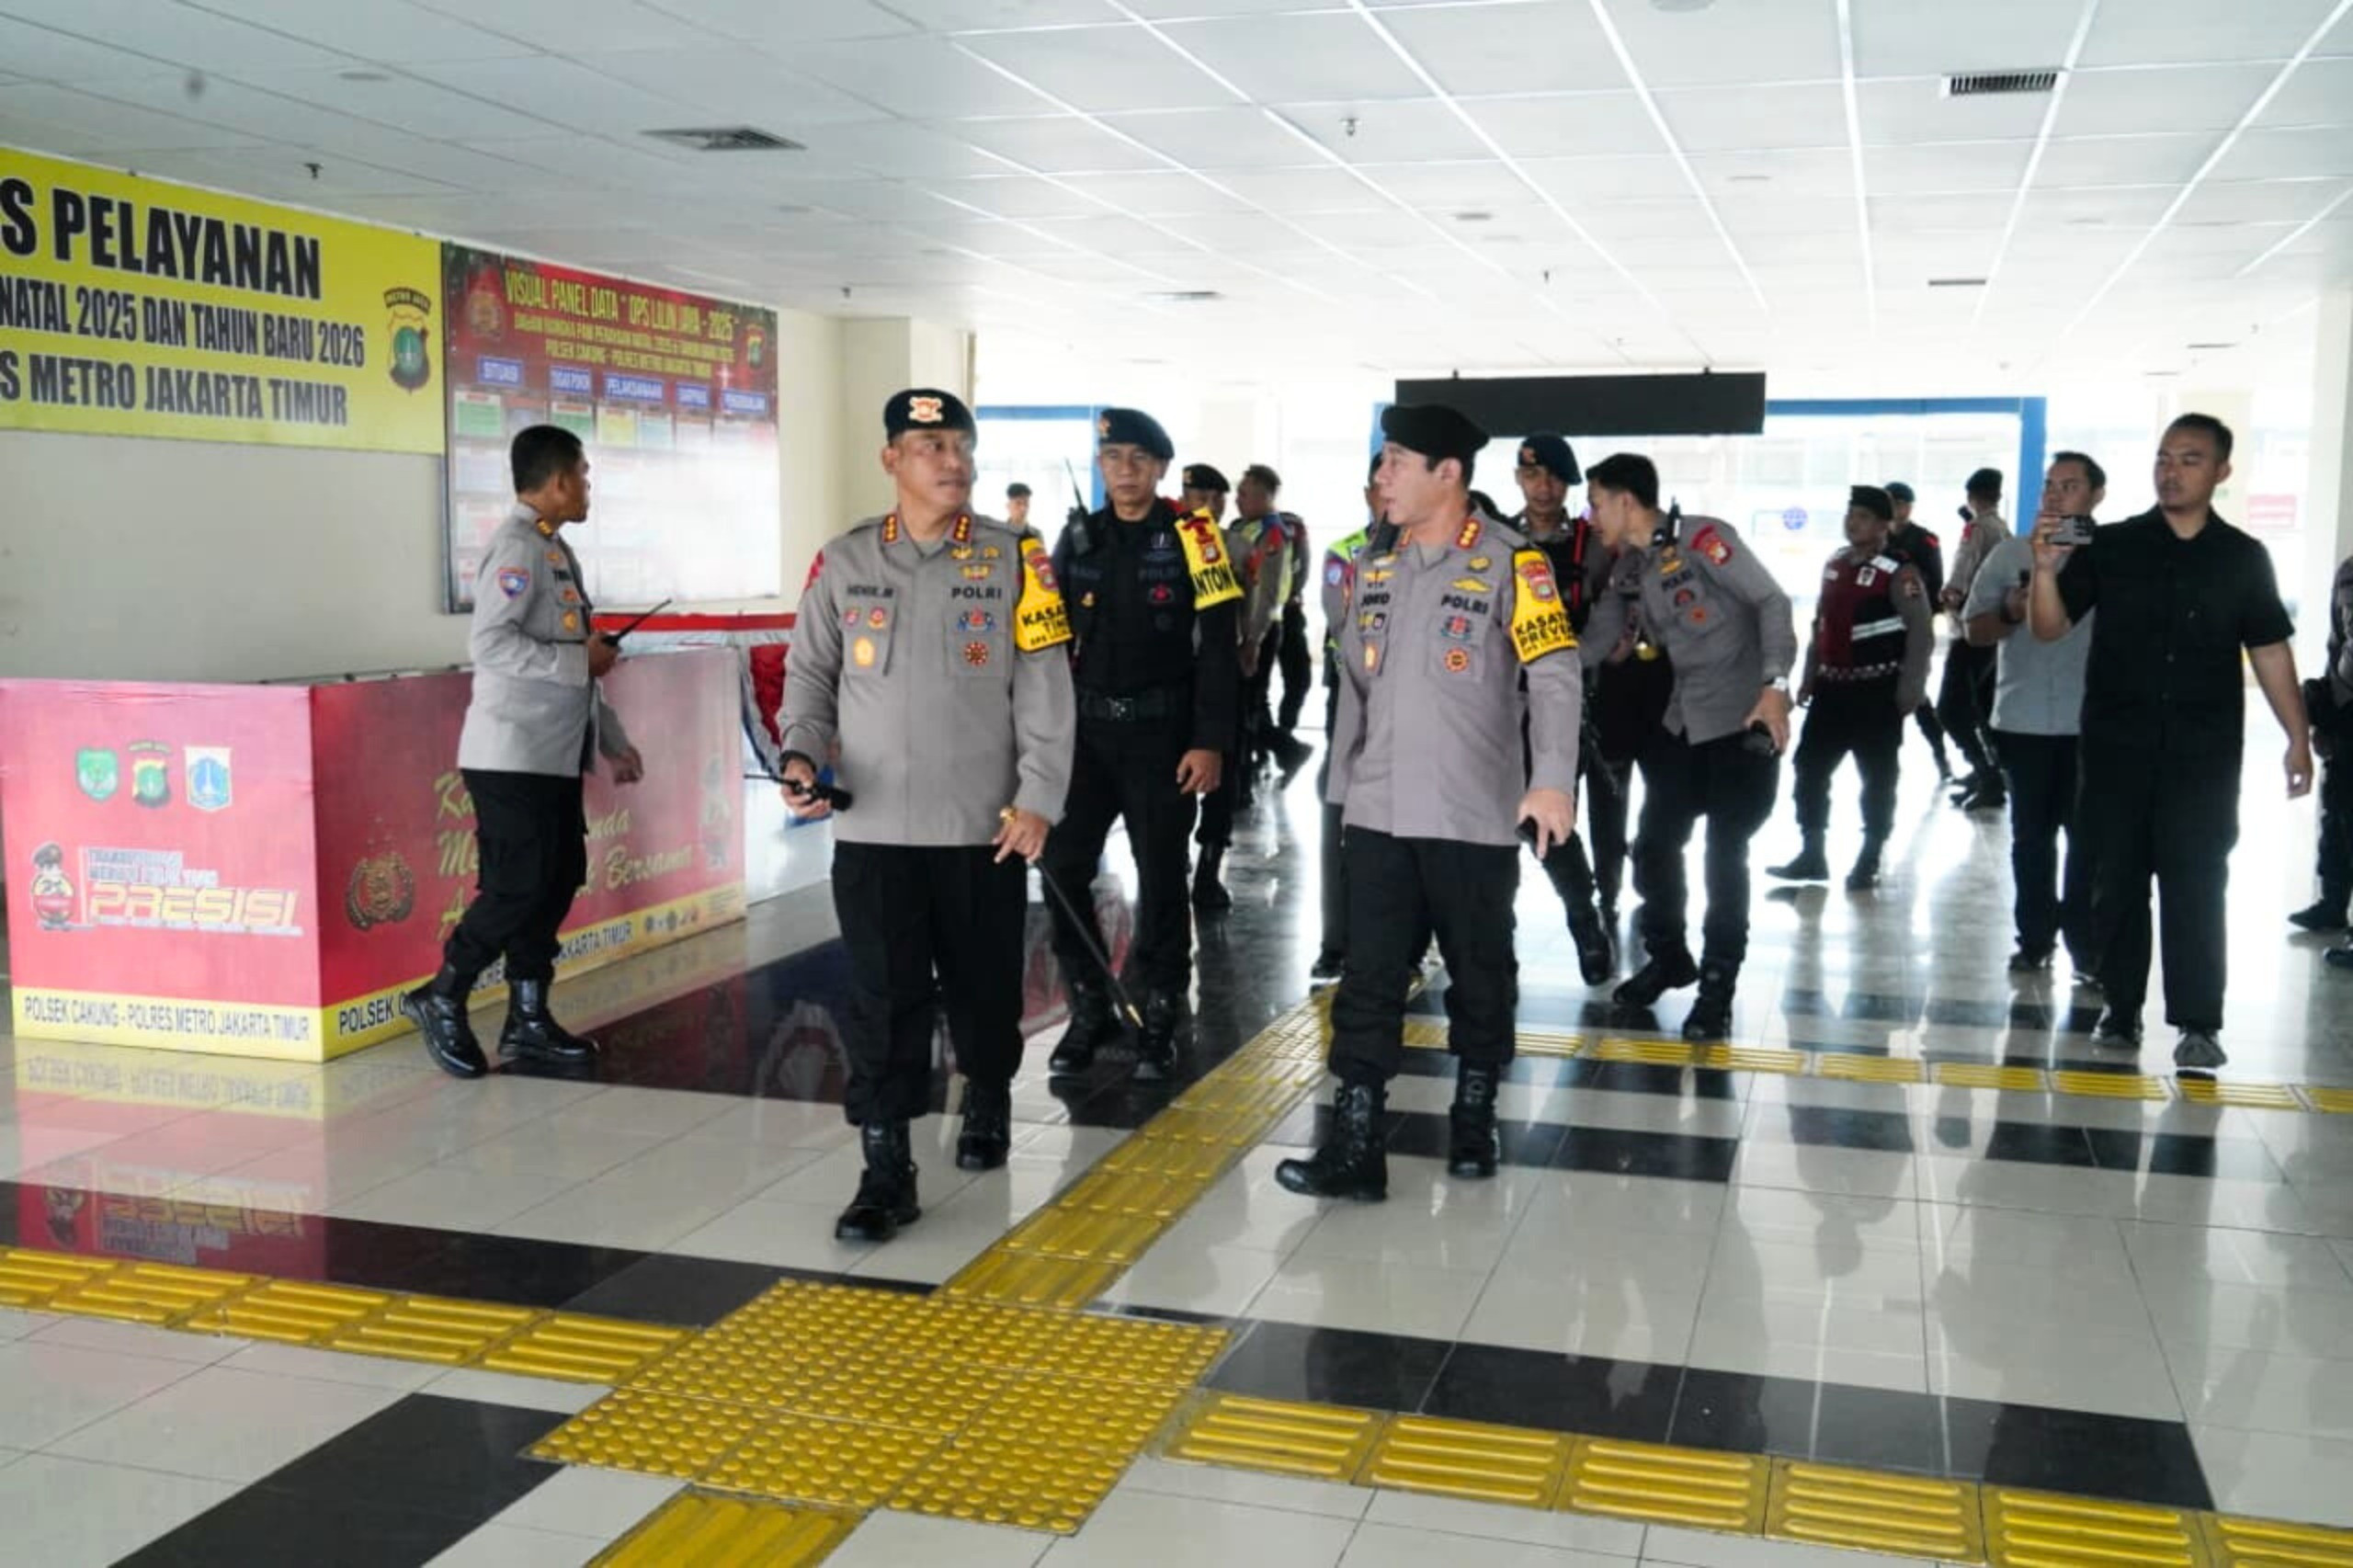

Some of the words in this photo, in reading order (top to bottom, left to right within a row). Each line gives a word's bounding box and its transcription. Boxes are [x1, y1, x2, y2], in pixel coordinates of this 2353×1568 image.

[52, 188, 321, 300] PELAYANAN
[506, 270, 550, 310] VISUAL
[551, 278, 589, 317] PANEL
[591, 287, 619, 322] DATA
[0, 275, 71, 334] NATAL
[76, 286, 137, 342] 2025
[143, 297, 186, 347] DAN
[191, 303, 258, 356] TAHUN
[264, 313, 313, 362] BARU
[318, 321, 365, 368] 2026
[29, 354, 136, 410] METRO
[144, 365, 264, 419] JAKARTA
[268, 379, 347, 426] TIMUR
[951, 587, 1002, 599] POLRI
[1440, 593, 1489, 615] POLRI
[603, 843, 693, 890] Bersama
[90, 880, 299, 928] PRESISI
[338, 995, 395, 1036] POLSEK
[602, 921, 634, 948] TIMUR
[25, 995, 68, 1023] POLSEK
[71, 998, 119, 1028] CAKUNG
[127, 1003, 174, 1031] POLRES
[176, 1006, 217, 1036] METRO
[219, 1009, 273, 1040] JAKARTA
[274, 1014, 311, 1041] TIMUR
